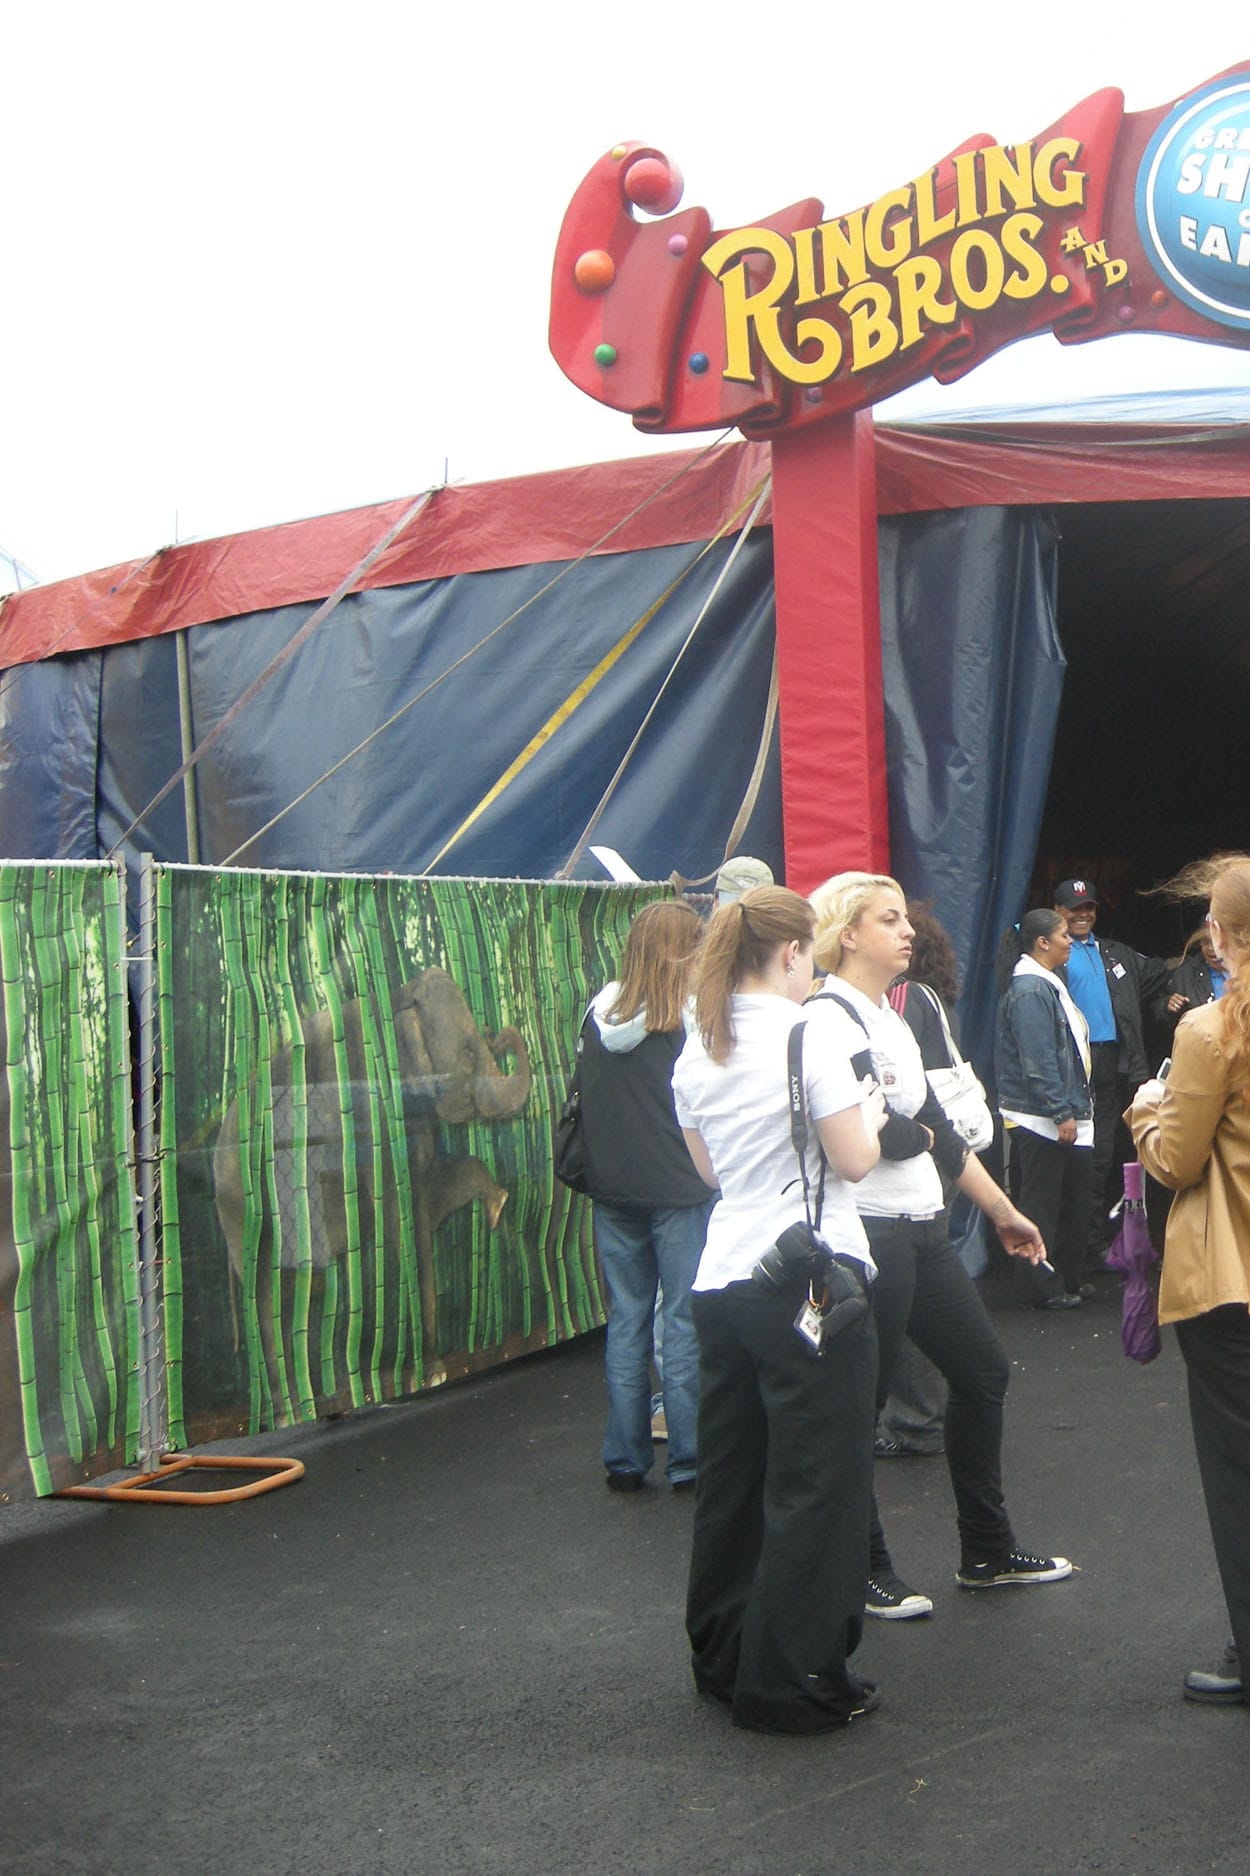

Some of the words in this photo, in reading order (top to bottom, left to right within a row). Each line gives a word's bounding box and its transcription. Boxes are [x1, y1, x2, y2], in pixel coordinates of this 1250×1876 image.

[700, 137, 1089, 384] RINGLING
[839, 212, 1069, 374] BROS.
[1060, 228, 1128, 287] AND
[792, 1075, 800, 1112] SONY
